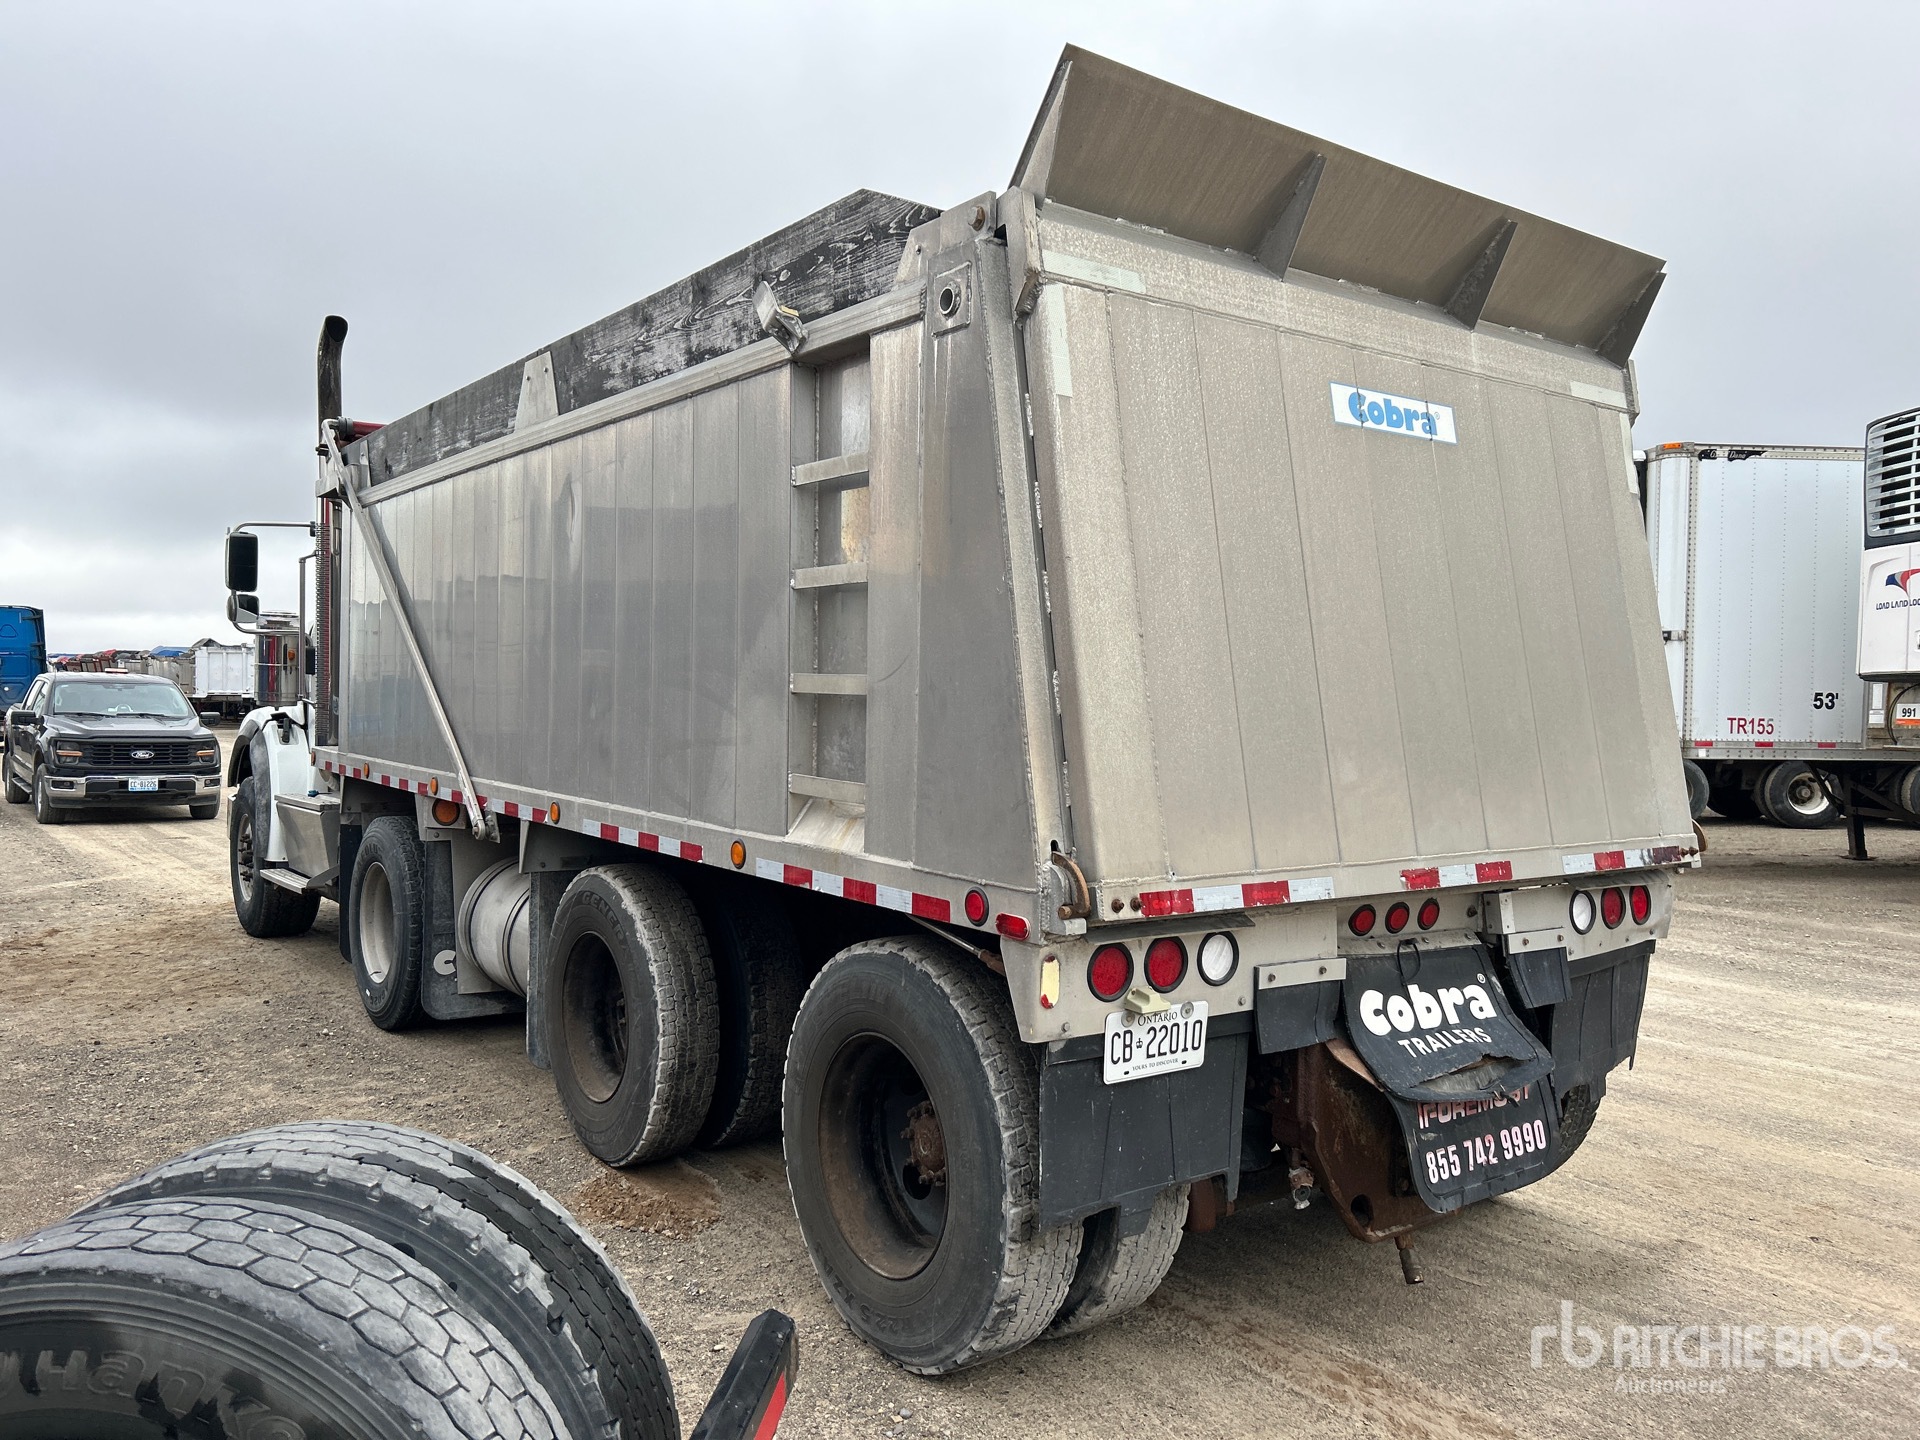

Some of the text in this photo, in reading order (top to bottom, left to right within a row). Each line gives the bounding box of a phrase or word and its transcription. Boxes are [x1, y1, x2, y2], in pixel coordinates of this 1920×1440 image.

[1348, 391, 1438, 436] Cobra
[1726, 717, 1774, 735] TR155
[1359, 983, 1498, 1036] Cobra
[1145, 1019, 1203, 1059] 22010
[1397, 1027, 1493, 1058] TRAILERS
[1132, 1064, 1148, 1072] YOURS
[1156, 1057, 1179, 1068] DISCOVER
[1425, 1119, 1547, 1184] 855 742 9990
